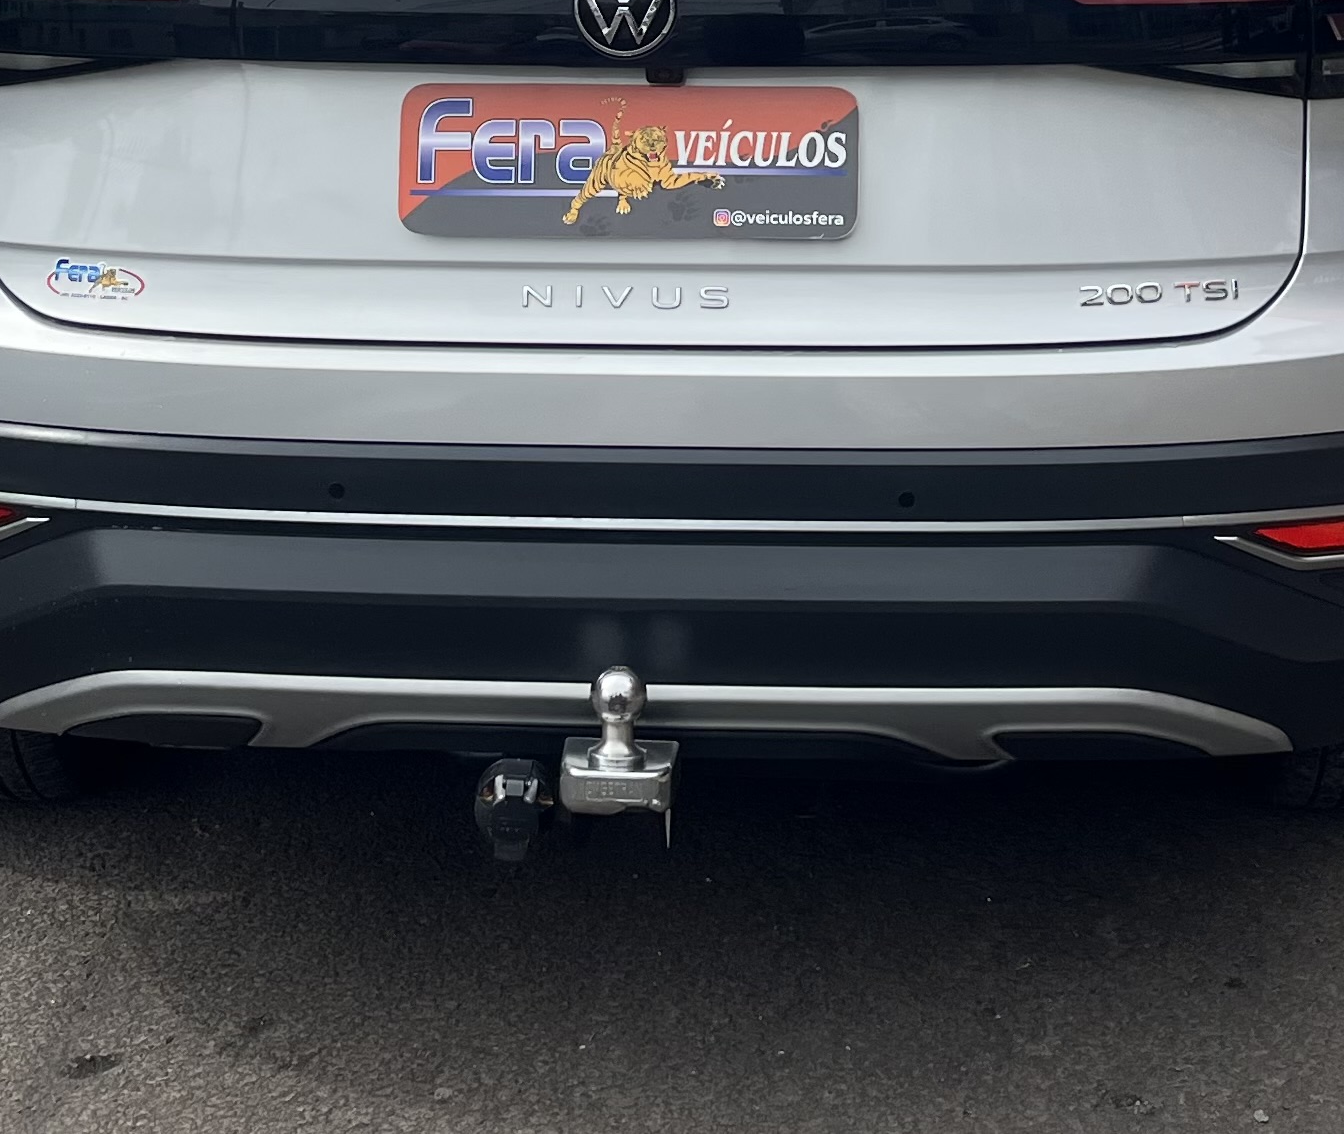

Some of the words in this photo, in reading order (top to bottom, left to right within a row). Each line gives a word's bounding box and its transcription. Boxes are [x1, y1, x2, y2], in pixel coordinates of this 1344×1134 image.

[674, 120, 848, 169] VEÍCULOS
[730, 211, 844, 228] @veiculosfera
[521, 284, 730, 309] NIVUS
[1079, 281, 1163, 307] 200
[1173, 278, 1239, 303] TSI
